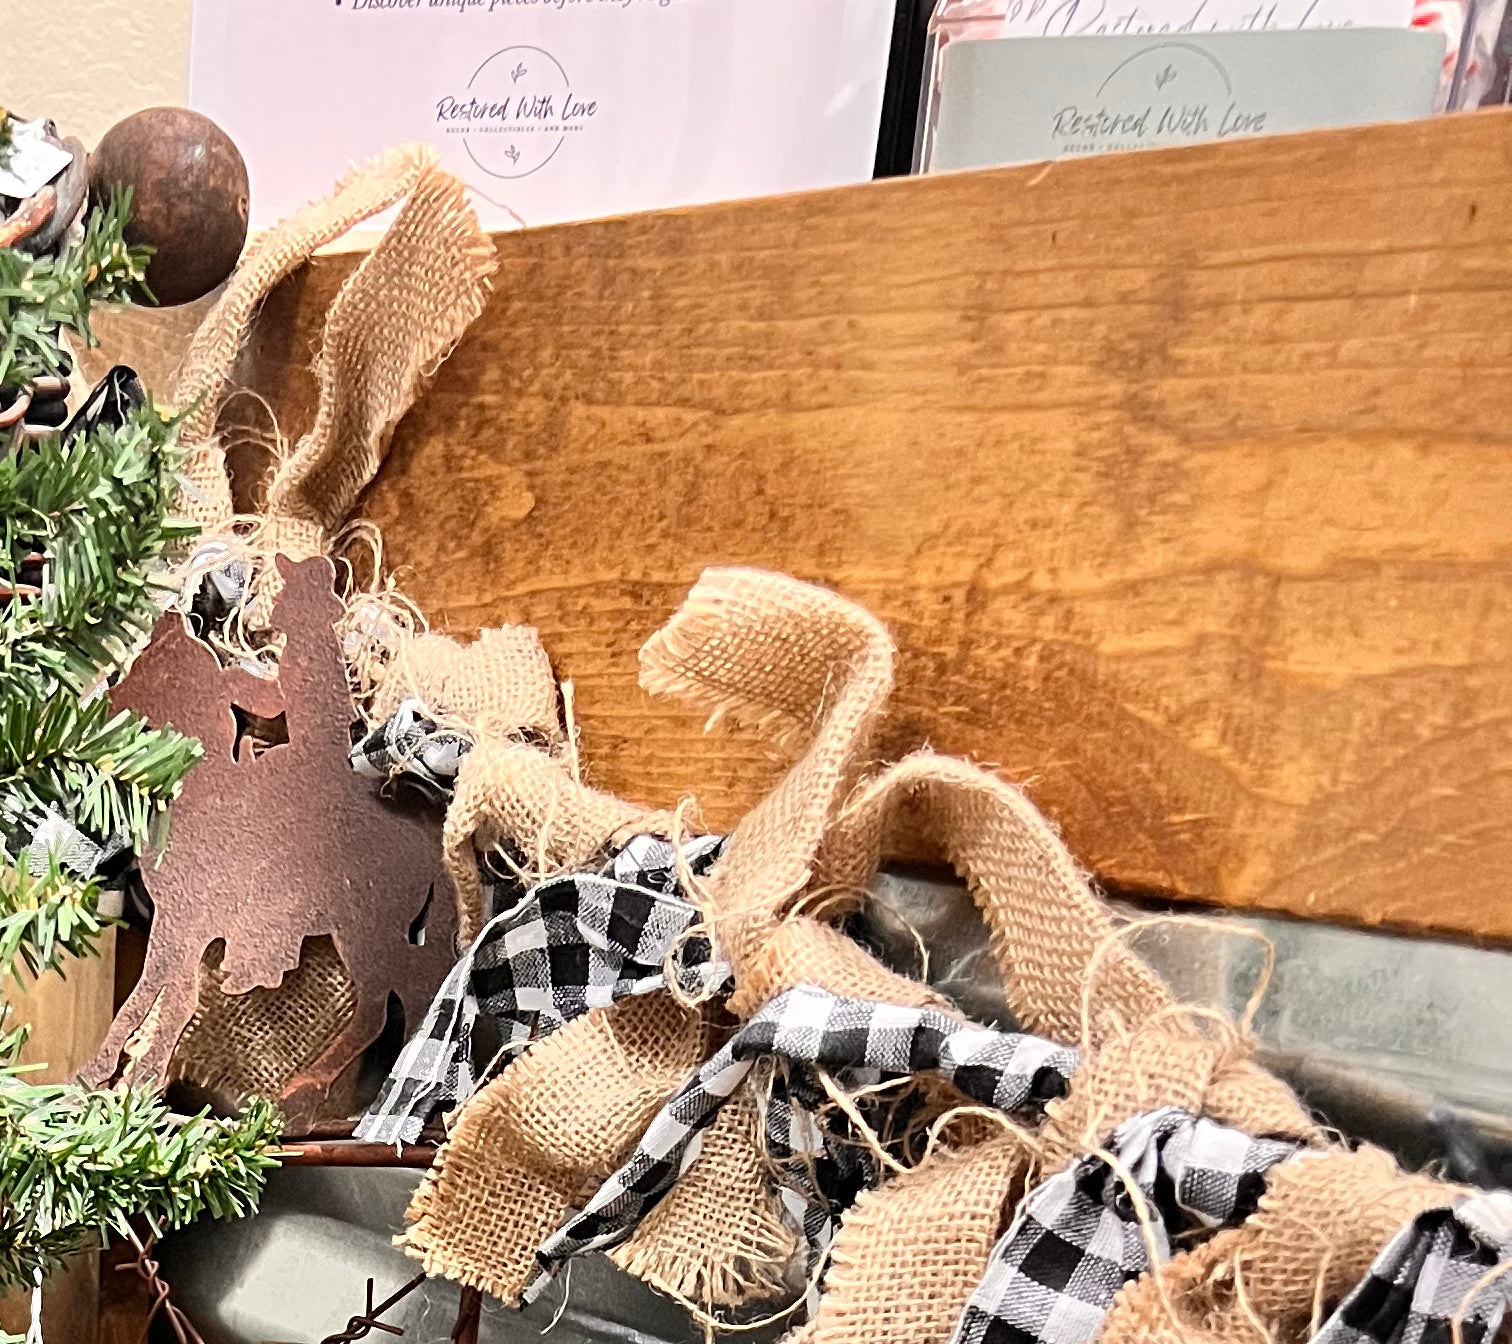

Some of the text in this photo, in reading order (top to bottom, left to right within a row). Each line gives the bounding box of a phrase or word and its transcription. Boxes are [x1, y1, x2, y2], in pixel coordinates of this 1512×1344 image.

[436, 93, 598, 122] Restored With Love
[1052, 101, 1268, 139] Restored With Love
